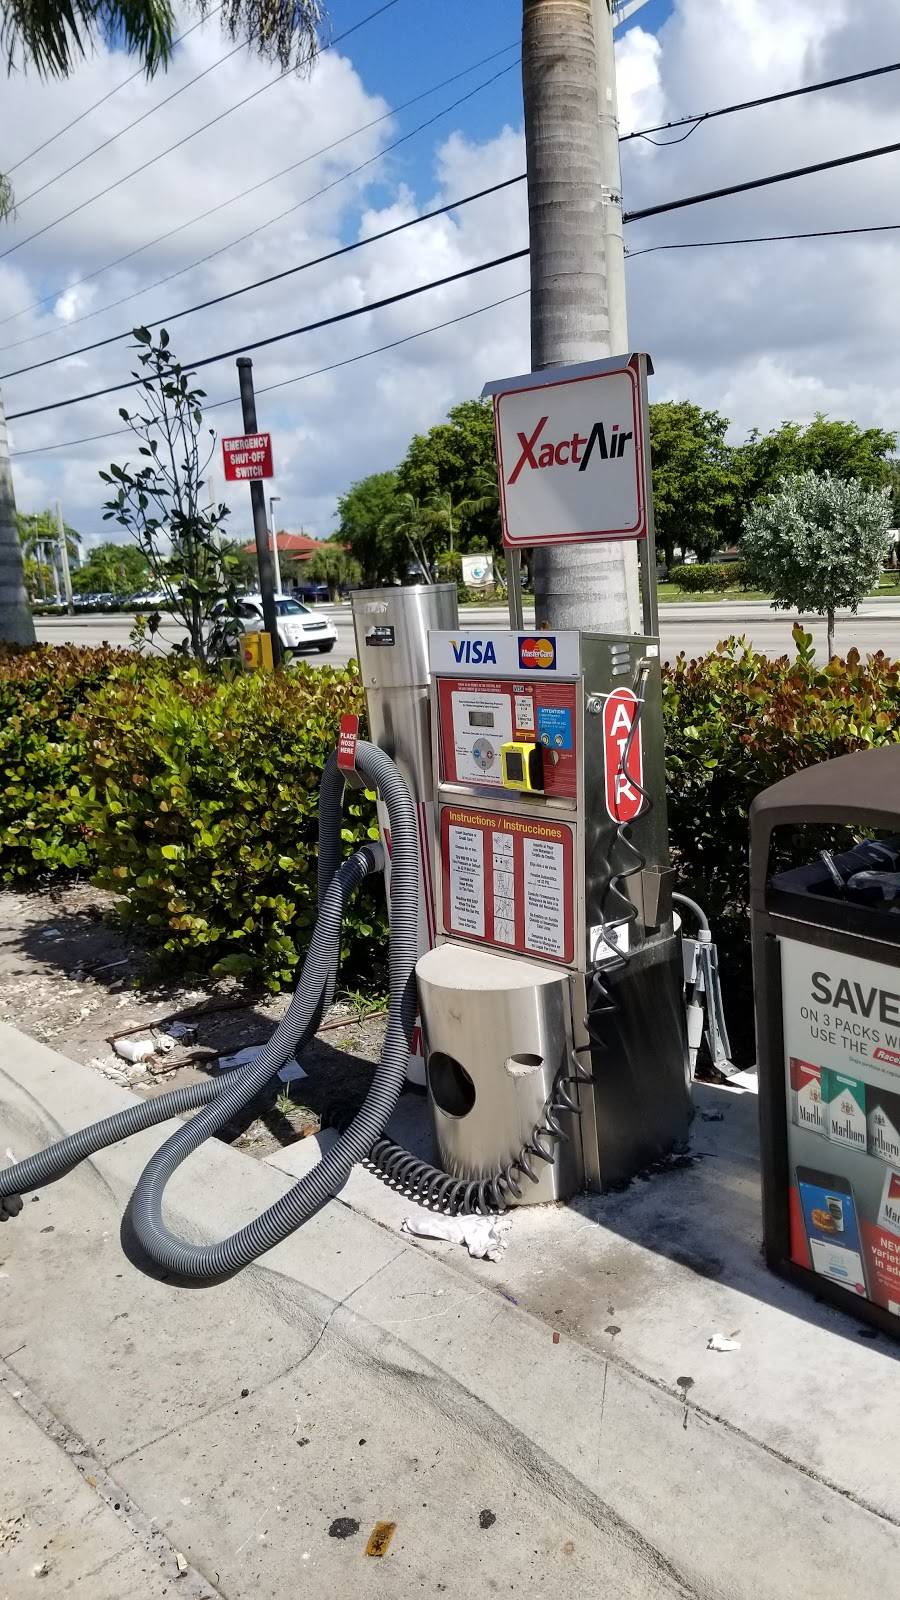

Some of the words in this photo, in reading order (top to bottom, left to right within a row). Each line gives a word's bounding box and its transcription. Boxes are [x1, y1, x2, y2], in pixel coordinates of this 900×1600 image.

[224, 436, 269, 452] EMERGENCY
[507, 416, 633, 486] XactAir
[230, 451, 265, 465] SHUT-OFF
[235, 465, 263, 478] SWITCH
[449, 640, 497, 664] VISA
[521, 648, 555, 659] MasterCard
[340, 732, 357, 740] PLACE
[340, 746, 354, 755] HERE
[610, 703, 637, 805] AIR
[449, 811, 496, 828] Instructions
[503, 819, 562, 838] Instrucciones
[810, 971, 900, 1028] SAVE
[800, 1006, 818, 1022] ON
[823, 1013, 831, 1027] 3
[835, 1017, 880, 1043] PACKS
[885, 1032, 900, 1051] W
[810, 1025, 837, 1045] USE
[840, 1035, 868, 1056] THE
[877, 1051, 900, 1068] Race
[832, 1119, 865, 1144] Marlboro
[886, 1204, 900, 1224] Mar
[871, 1246, 900, 1265] variet
[875, 1256, 884, 1269] in
